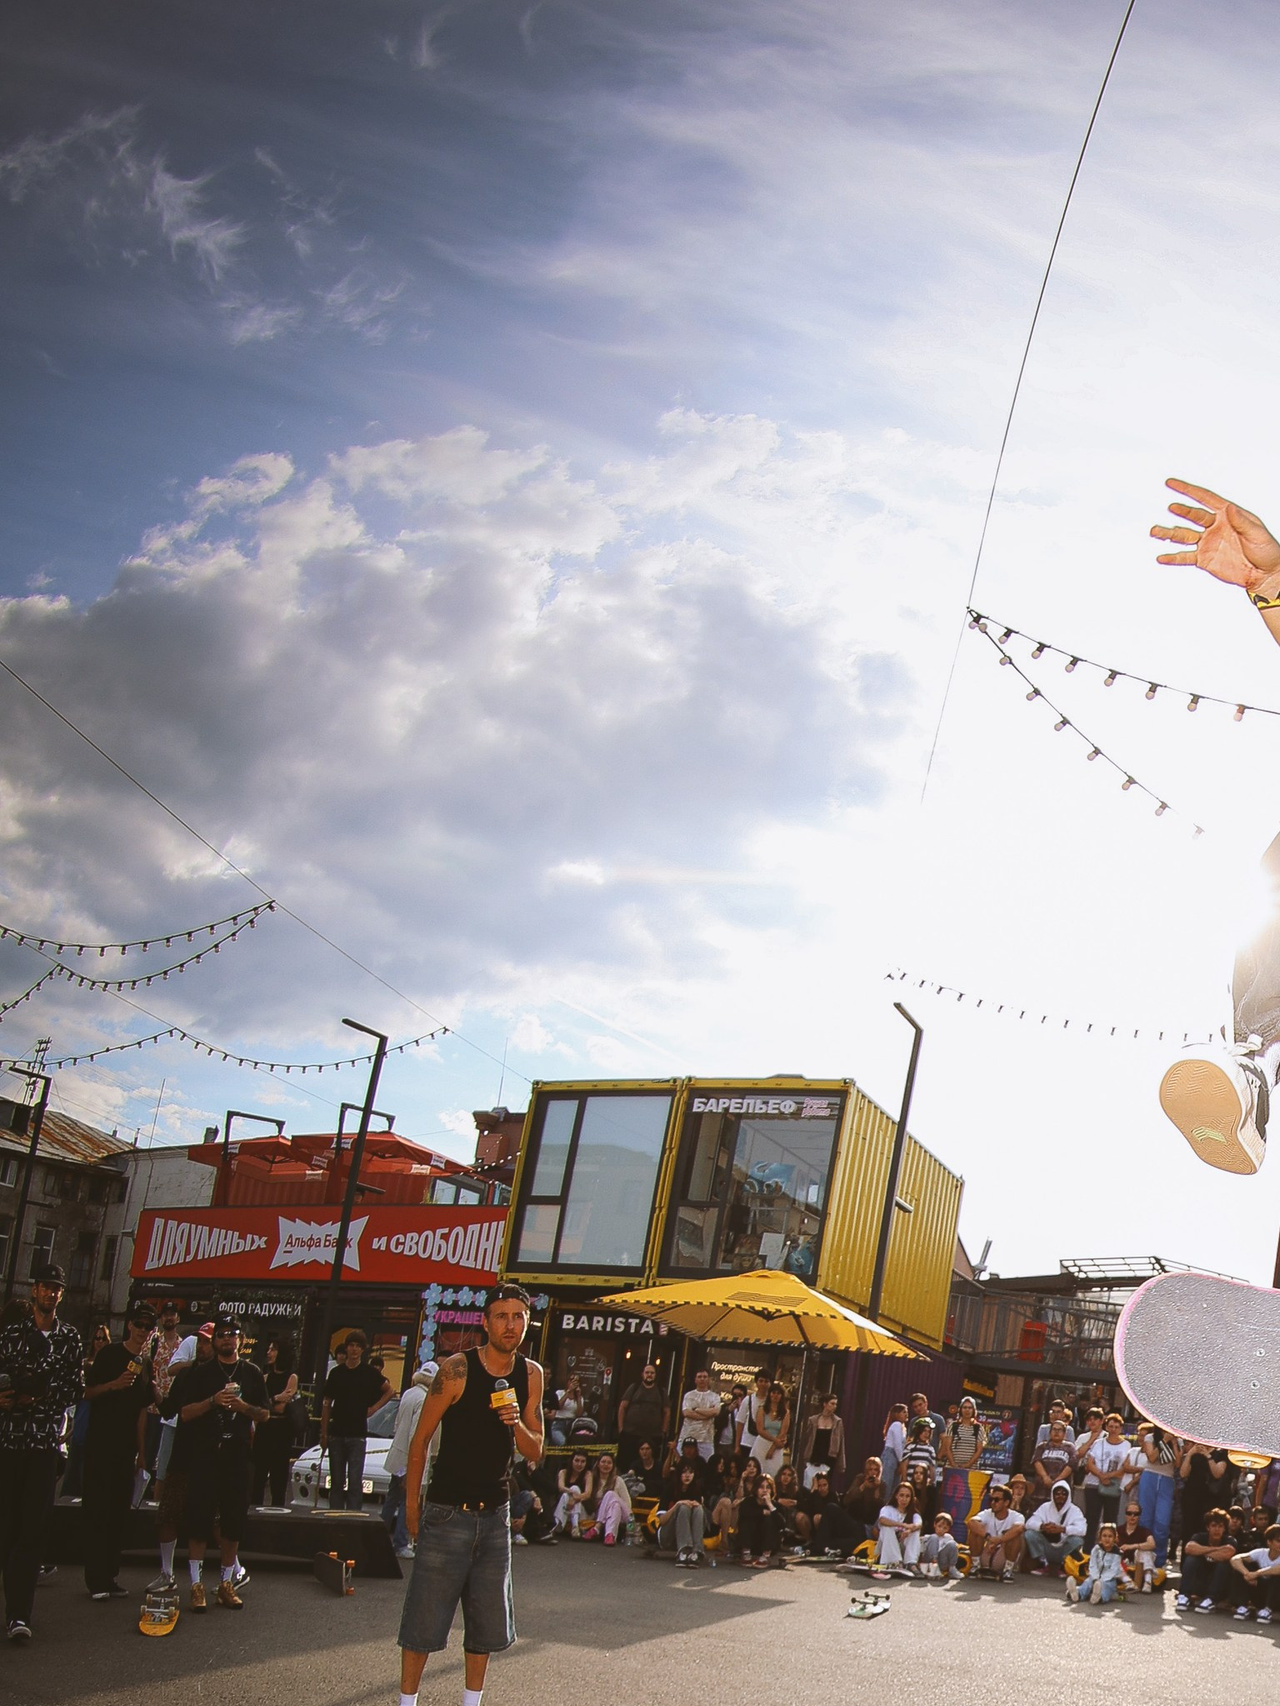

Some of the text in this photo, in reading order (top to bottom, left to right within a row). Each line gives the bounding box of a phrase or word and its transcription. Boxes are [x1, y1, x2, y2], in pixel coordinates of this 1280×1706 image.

[692, 1098, 797, 1114] БАРЕЛЬЕФ
[284, 1233, 353, 1253] Альфа Бак
[219, 1301, 246, 1315] ФОТО
[562, 1314, 654, 1335] BARISTA
[711, 1361, 763, 1372] Пространств
